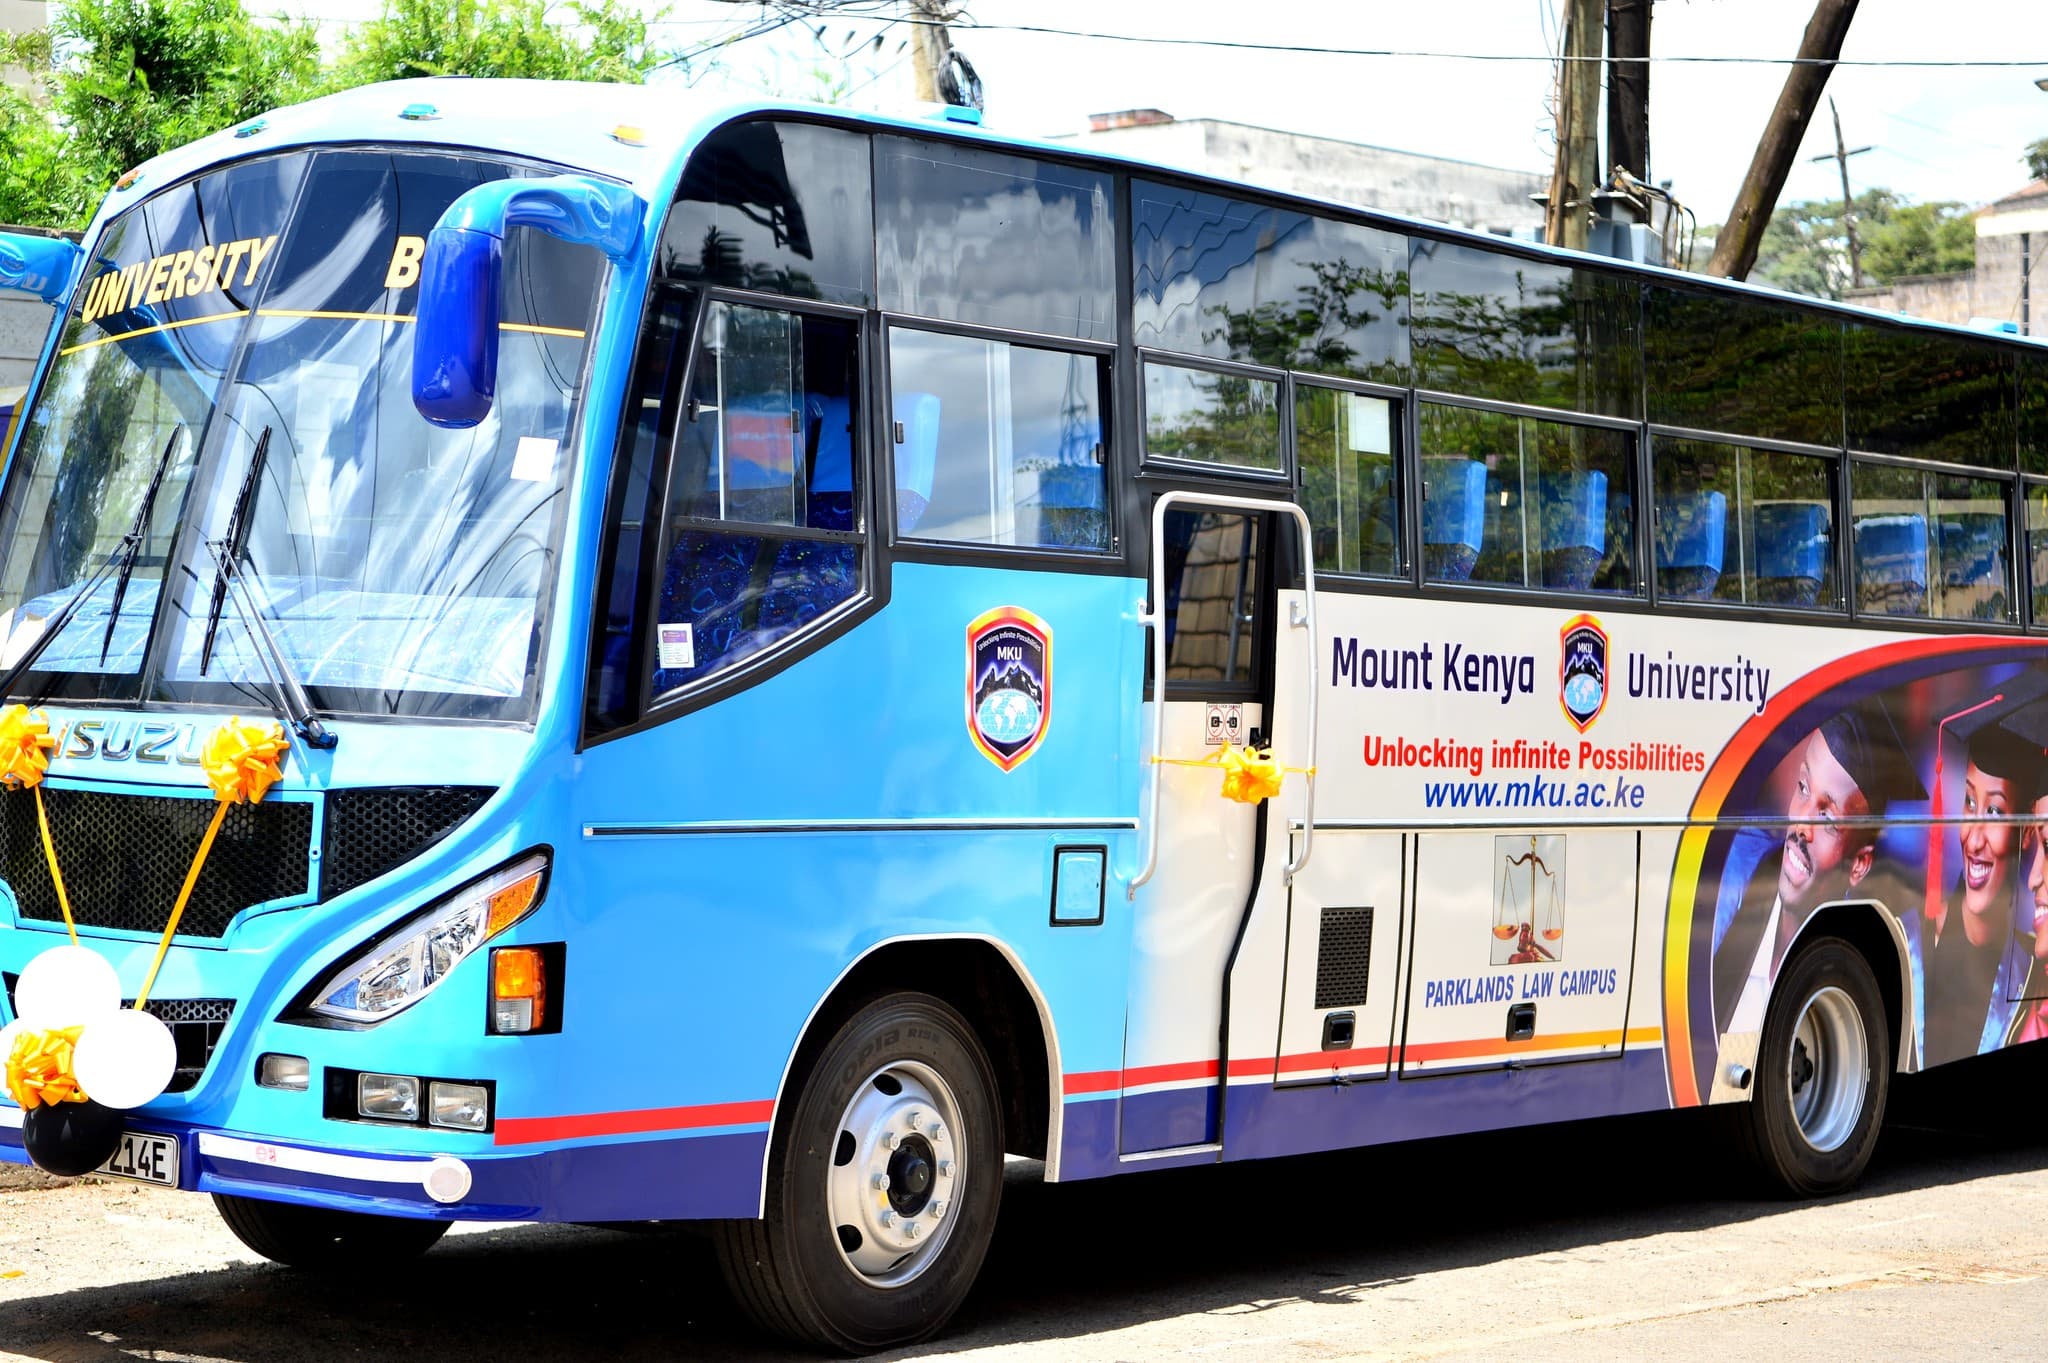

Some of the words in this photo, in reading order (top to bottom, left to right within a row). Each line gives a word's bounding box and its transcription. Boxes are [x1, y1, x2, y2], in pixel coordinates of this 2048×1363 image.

[82, 235, 279, 323] UNIVERSITY
[997, 646, 1022, 661] MKU
[1577, 642, 1593, 654] MKU
[1332, 636, 1433, 689] Mount
[1443, 643, 1535, 704] Kenya
[1628, 651, 1770, 712] University
[53, 719, 203, 766] ISUZU
[1363, 735, 1483, 775] Unlocking
[1491, 740, 1571, 770] infinite
[1578, 740, 1705, 772] Possibilities
[1424, 774, 1645, 808] www.mku.ac.ke
[1425, 974, 1515, 1008] PARKLANDS
[1522, 971, 1553, 999] LAW
[1560, 968, 1617, 996] CAMPUS
